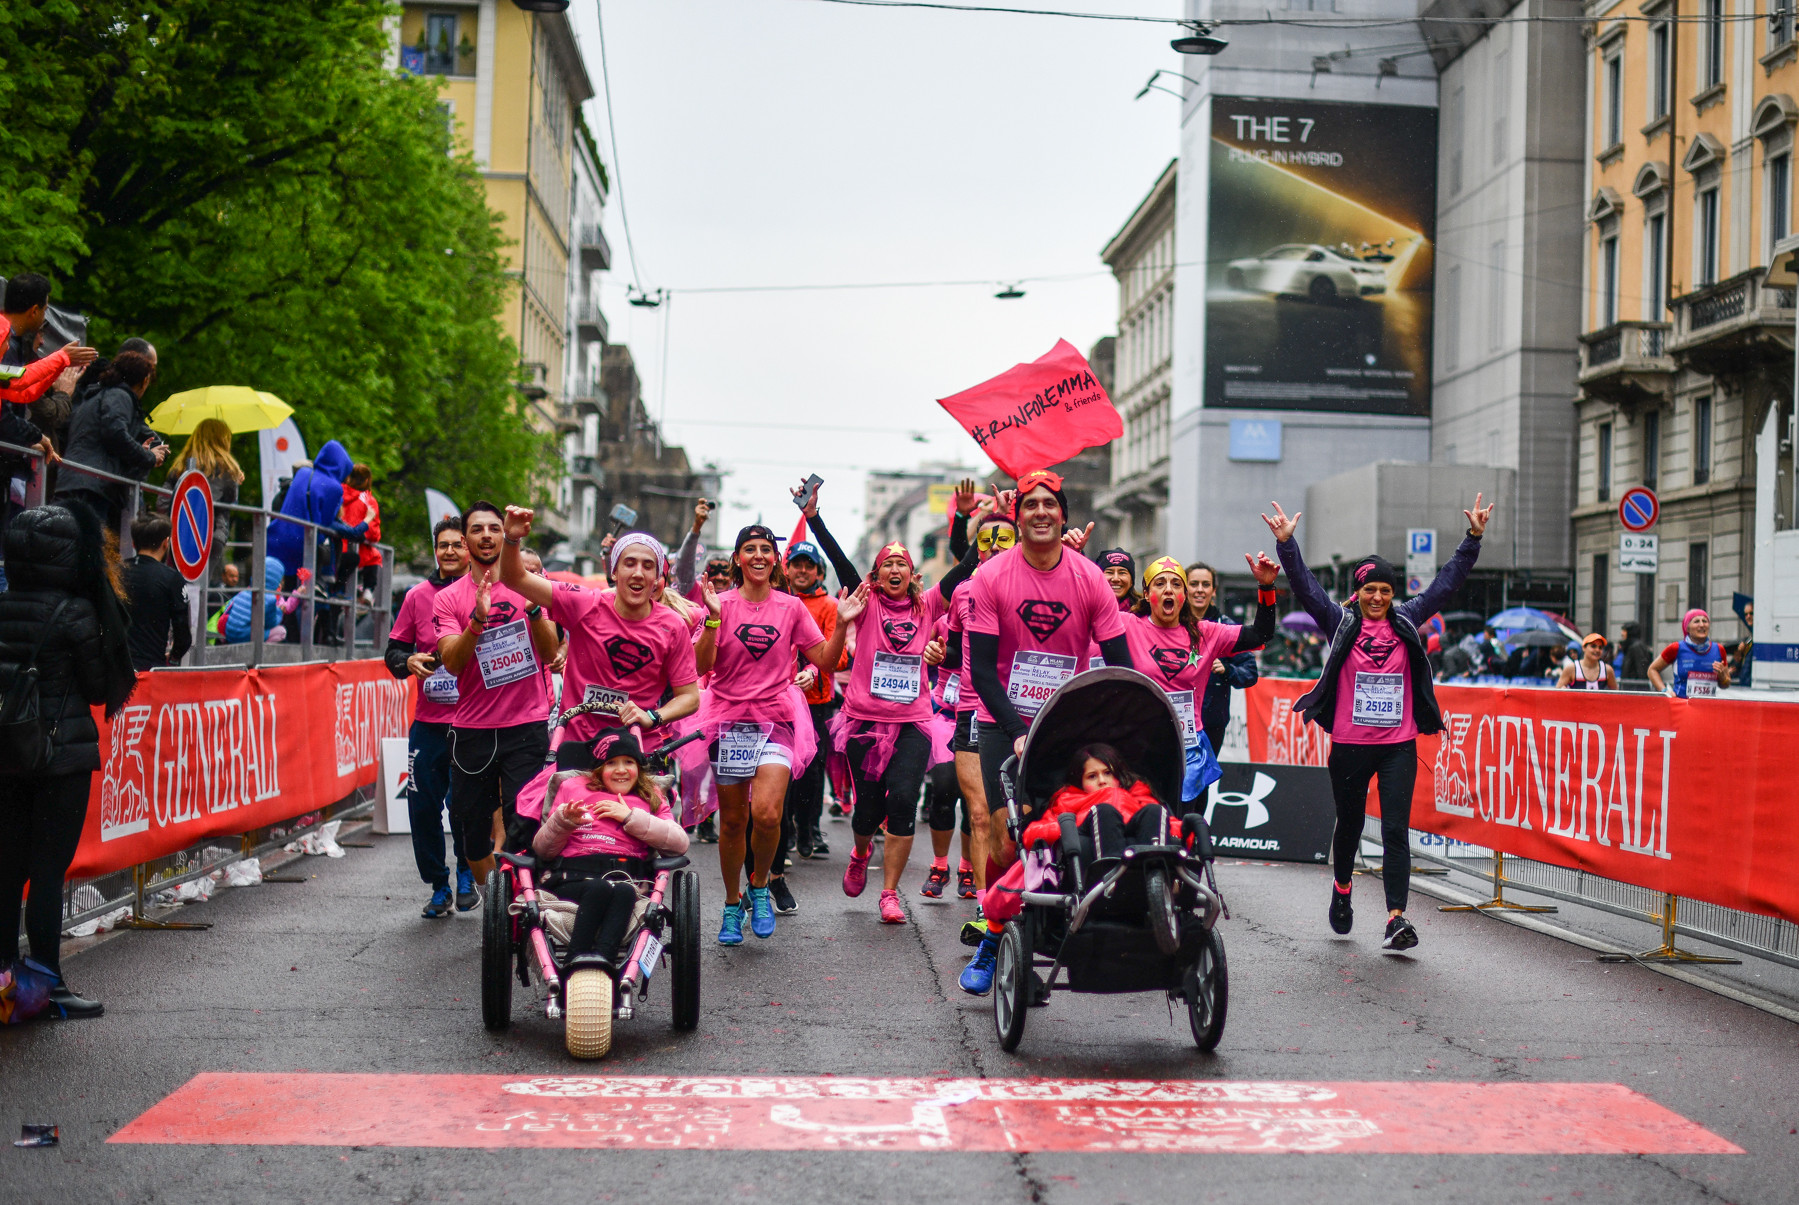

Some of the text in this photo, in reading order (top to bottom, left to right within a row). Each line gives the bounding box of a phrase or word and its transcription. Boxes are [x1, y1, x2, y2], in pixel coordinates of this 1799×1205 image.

[1229, 114, 1316, 144] THE 7
[1289, 150, 1344, 168] HYBRID
[971, 369, 1097, 447] #RUNFOREMMA
[1064, 392, 1102, 413] & friends
[1415, 535, 1428, 550] P
[490, 651, 524, 671] 2504D
[881, 677, 910, 690] 2494A
[1365, 700, 1393, 712] 2512B
[355, 679, 410, 769] GENERALI
[153, 693, 281, 828] GENERALI
[1474, 714, 1677, 861] GENERALI
[642, 938, 659, 968] VITTORIA
